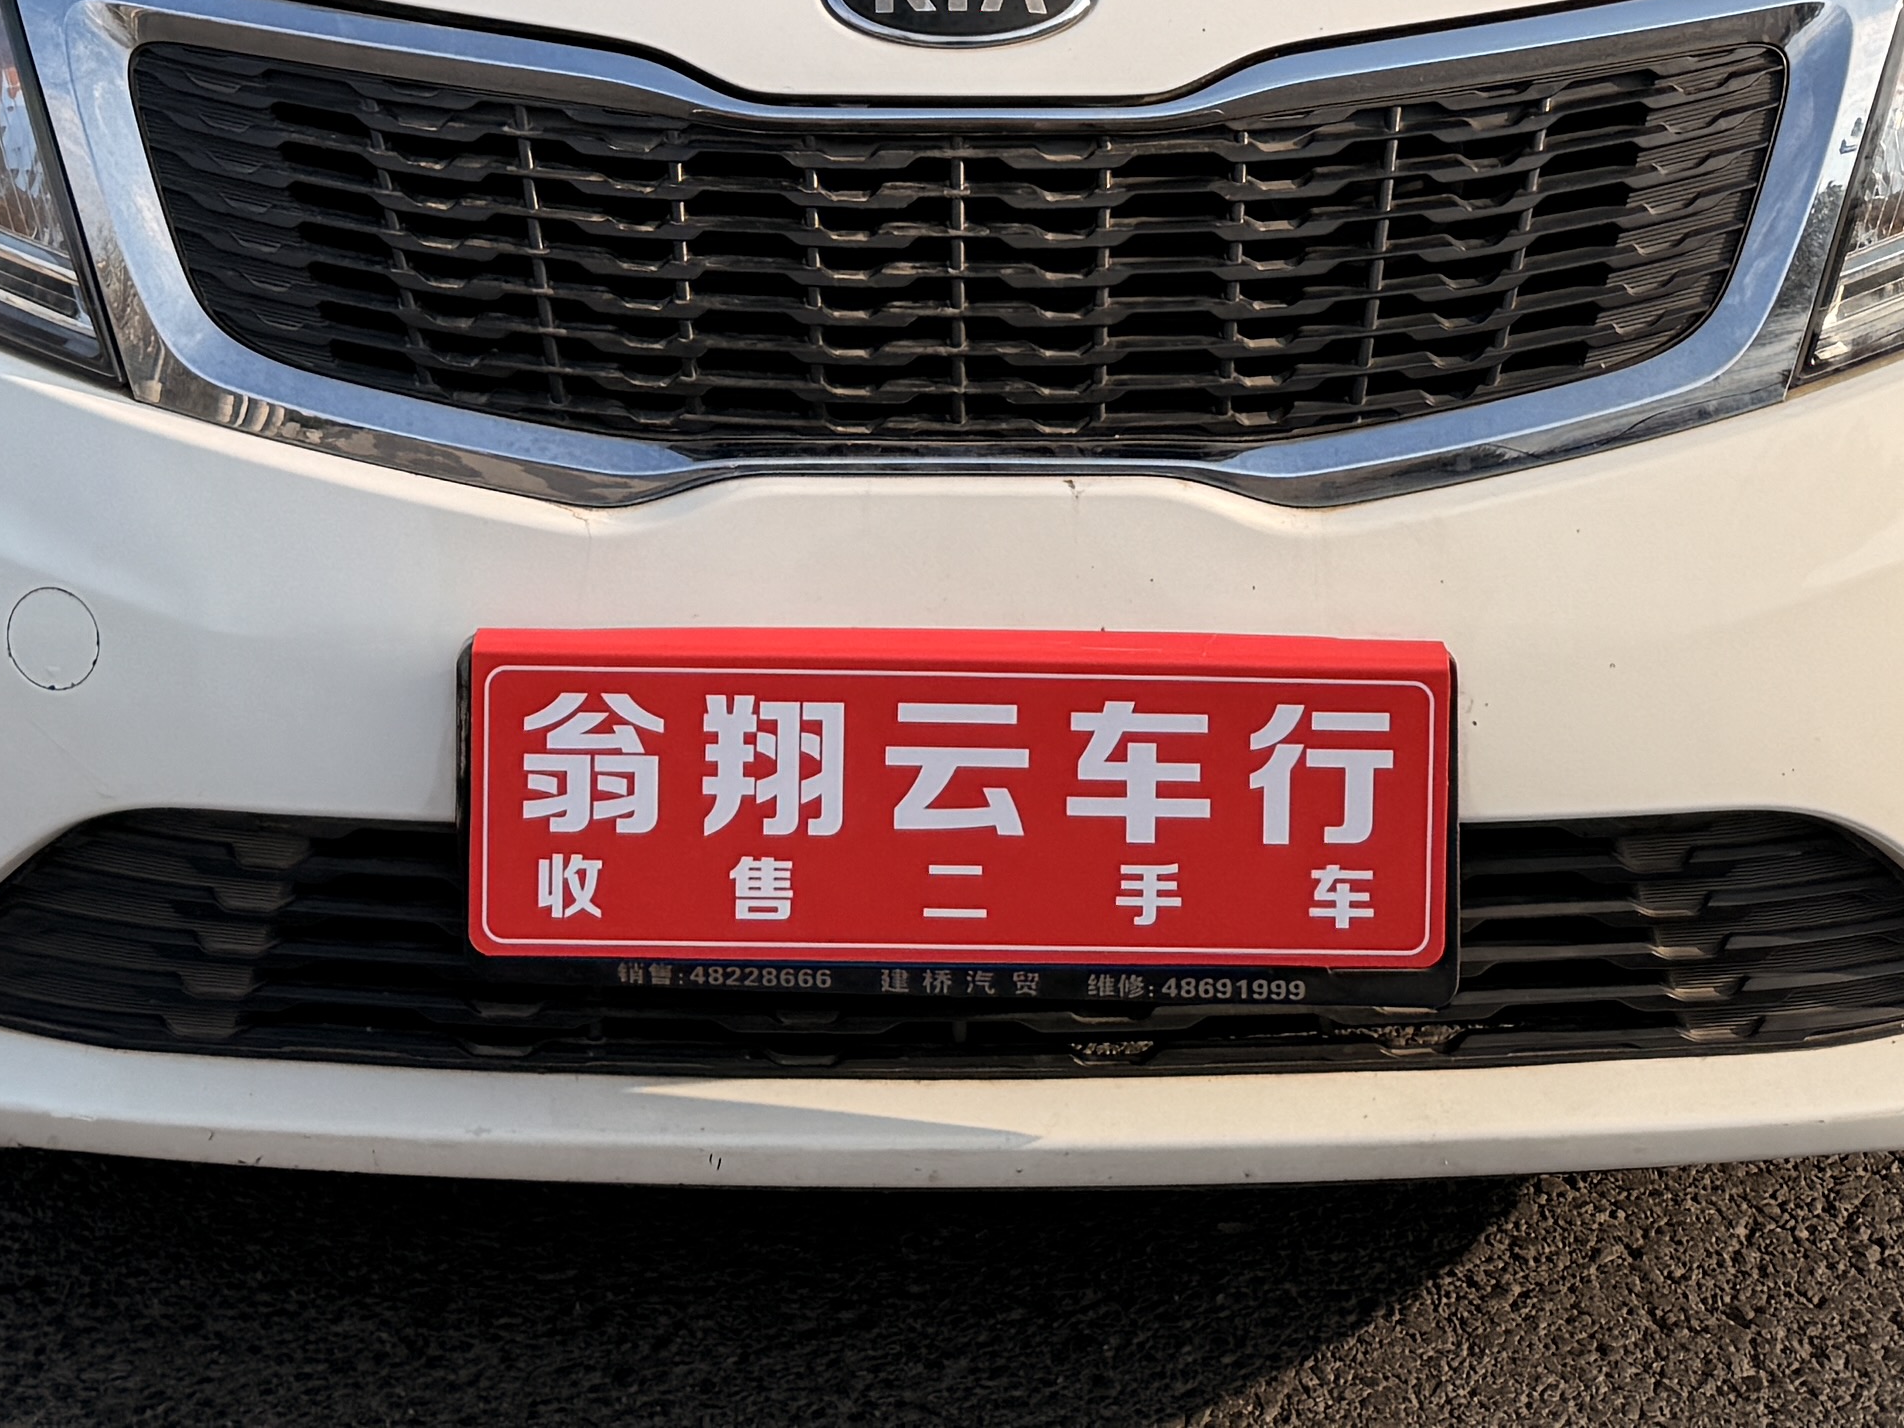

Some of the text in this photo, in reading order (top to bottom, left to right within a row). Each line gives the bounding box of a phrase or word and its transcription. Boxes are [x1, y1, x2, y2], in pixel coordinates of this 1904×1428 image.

[523, 692, 1394, 845] 翁翔云车行
[538, 852, 1375, 929] 收售二手车
